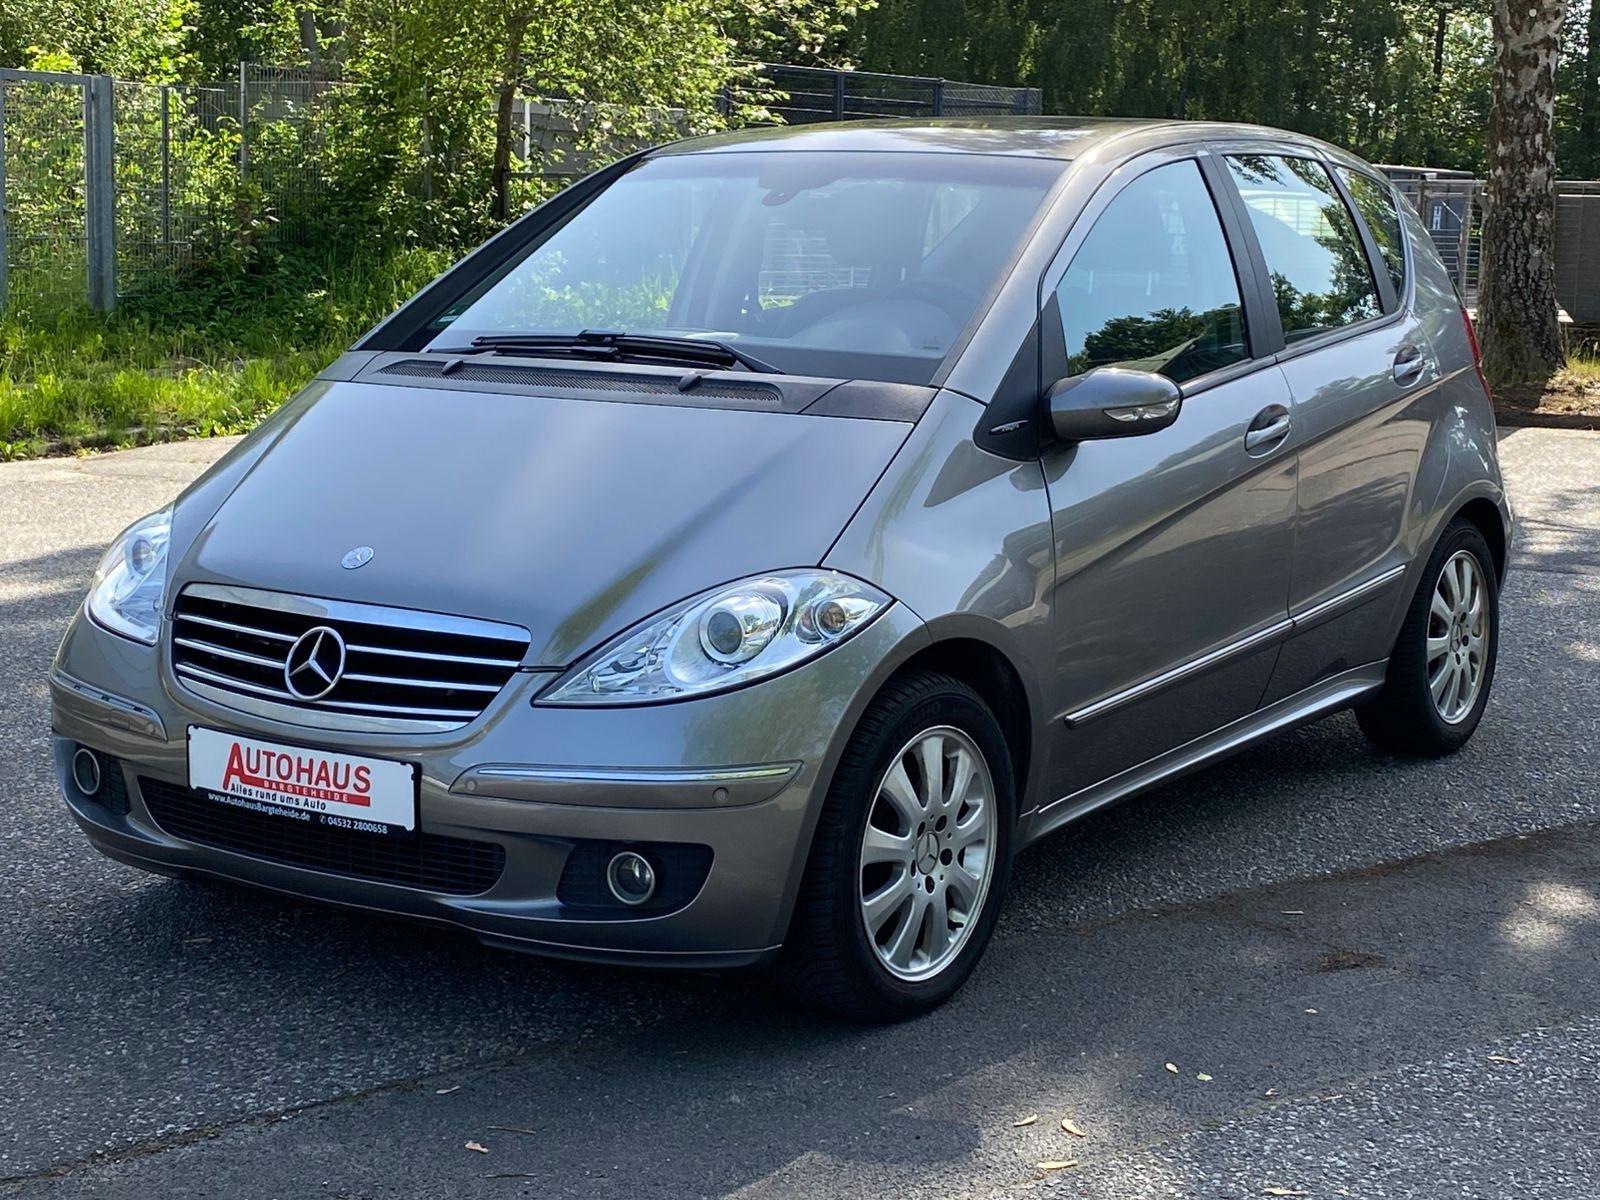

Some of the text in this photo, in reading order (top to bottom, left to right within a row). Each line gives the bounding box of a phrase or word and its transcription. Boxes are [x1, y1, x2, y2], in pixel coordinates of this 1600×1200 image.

[223, 742, 371, 793] AUTOHAUS
[230, 783, 326, 811] Alles rund ums Auto
[263, 780, 349, 802] BARGTEHEIDE
[207, 792, 388, 834] www.AutohausBargteheide.de 04532 2800658
